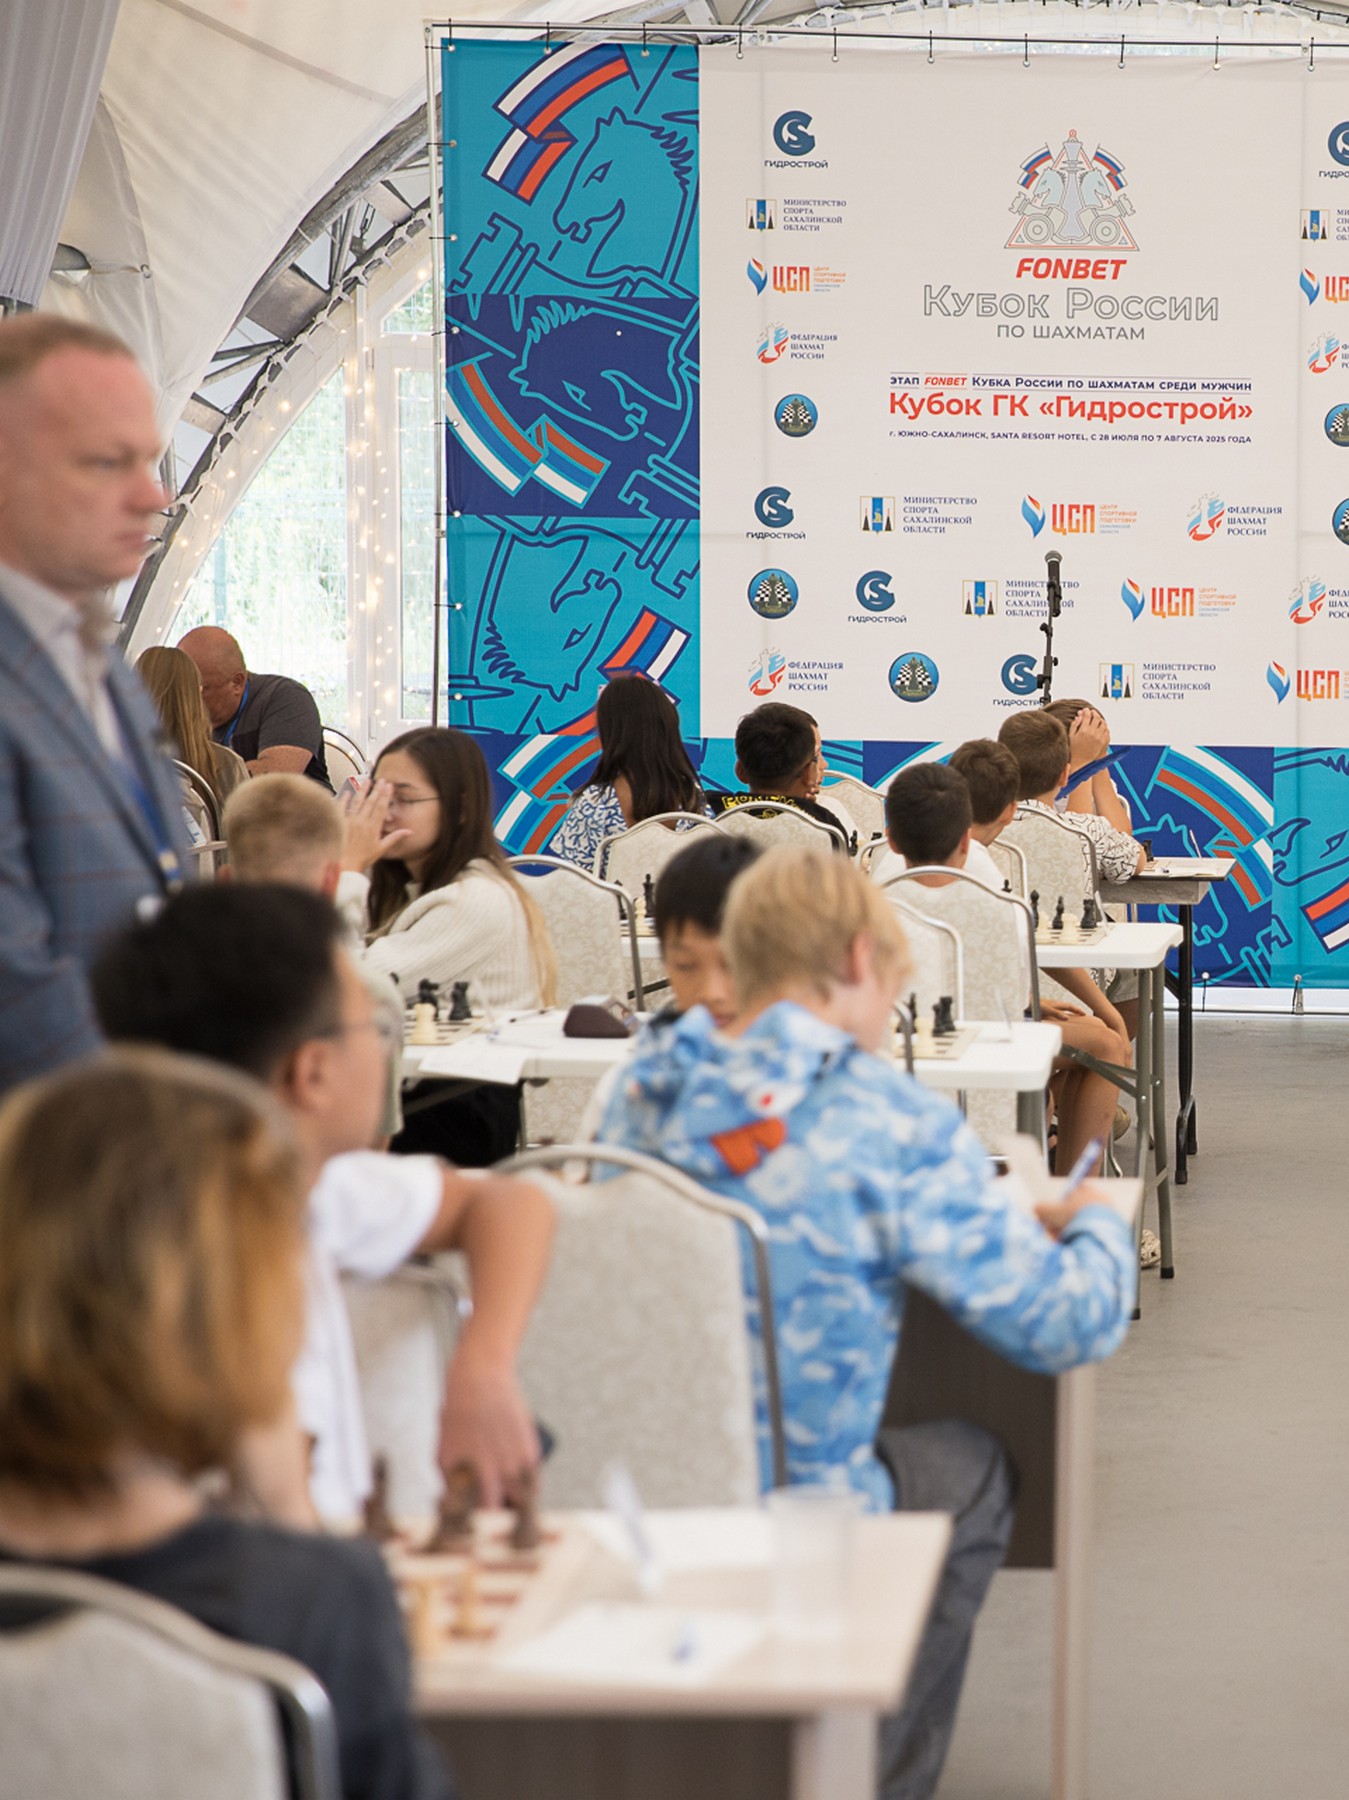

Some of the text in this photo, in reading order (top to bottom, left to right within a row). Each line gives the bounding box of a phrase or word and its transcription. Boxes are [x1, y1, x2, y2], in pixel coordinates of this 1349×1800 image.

[764, 159, 828, 169] ГИДРОСТРОЙ
[783, 199, 847, 207] МИНИСТЕРСТВО
[783, 207, 814, 215] СПОРТА
[783, 215, 843, 224] САХАЛИНСКОЙ
[1016, 258, 1127, 280] FONBET
[772, 266, 810, 294] ЦСП
[997, 324, 1145, 340] ПО ШАХМАТАМ
[790, 333, 838, 342] ФЕДЕРАЦИЯ
[790, 343, 825, 351] ШАХМАТ
[790, 352, 825, 360] РОССИИ
[890, 377, 919, 385] ЭТАП
[924, 377, 967, 386] FONBET
[1067, 380, 1084, 389] ПО
[1088, 380, 1154, 390] ШАХМАТАМ
[1159, 381, 1197, 391] СРЕДИ
[1201, 382, 1251, 391] МУЖЧИН
[890, 392, 1253, 425] Кубок ГК «Гидрострой»
[898, 430, 988, 440] ЮЖНО-САХАЛИНСК,
[1206, 435, 1226, 443] 2025
[1228, 436, 1251, 444] ГОДА
[903, 496, 978, 505] МИНИСТЕРСТВО
[903, 506, 939, 515] СПОРТА
[1227, 506, 1283, 515] ФЕДЕРАЦИЯ
[903, 515, 972, 524] САХАЛИНСКОЙ
[1052, 503, 1095, 536] ЦСП
[1227, 517, 1267, 525] ШАХМАТ
[903, 525, 946, 534] ОБЛАСТИ
[1227, 527, 1267, 536] РОССИИ
[746, 531, 806, 540] ГИДРОСТРОЙ
[1006, 580, 1079, 588] МИНИСТТВО
[1006, 599, 1074, 608] САХАЛИНОЙ
[1152, 587, 1194, 619] ЦСП
[1006, 609, 1047, 617] ОБЛАСТИ
[848, 614, 907, 624] ГИДРОСТРОЙ
[788, 661, 844, 670] ФЕДЕРАЦИЯ
[1142, 663, 1216, 672] МИНИСТЕРСТВО
[788, 672, 828, 681] ШАХМАТ
[1142, 673, 1177, 681] СПОРТА
[788, 683, 828, 691] РОССИИ
[1142, 682, 1211, 691] САХАЛИНСКОЙ
[1297, 669, 1340, 702] ЦСП
[1142, 692, 1185, 700] ОБЛАСТИ
